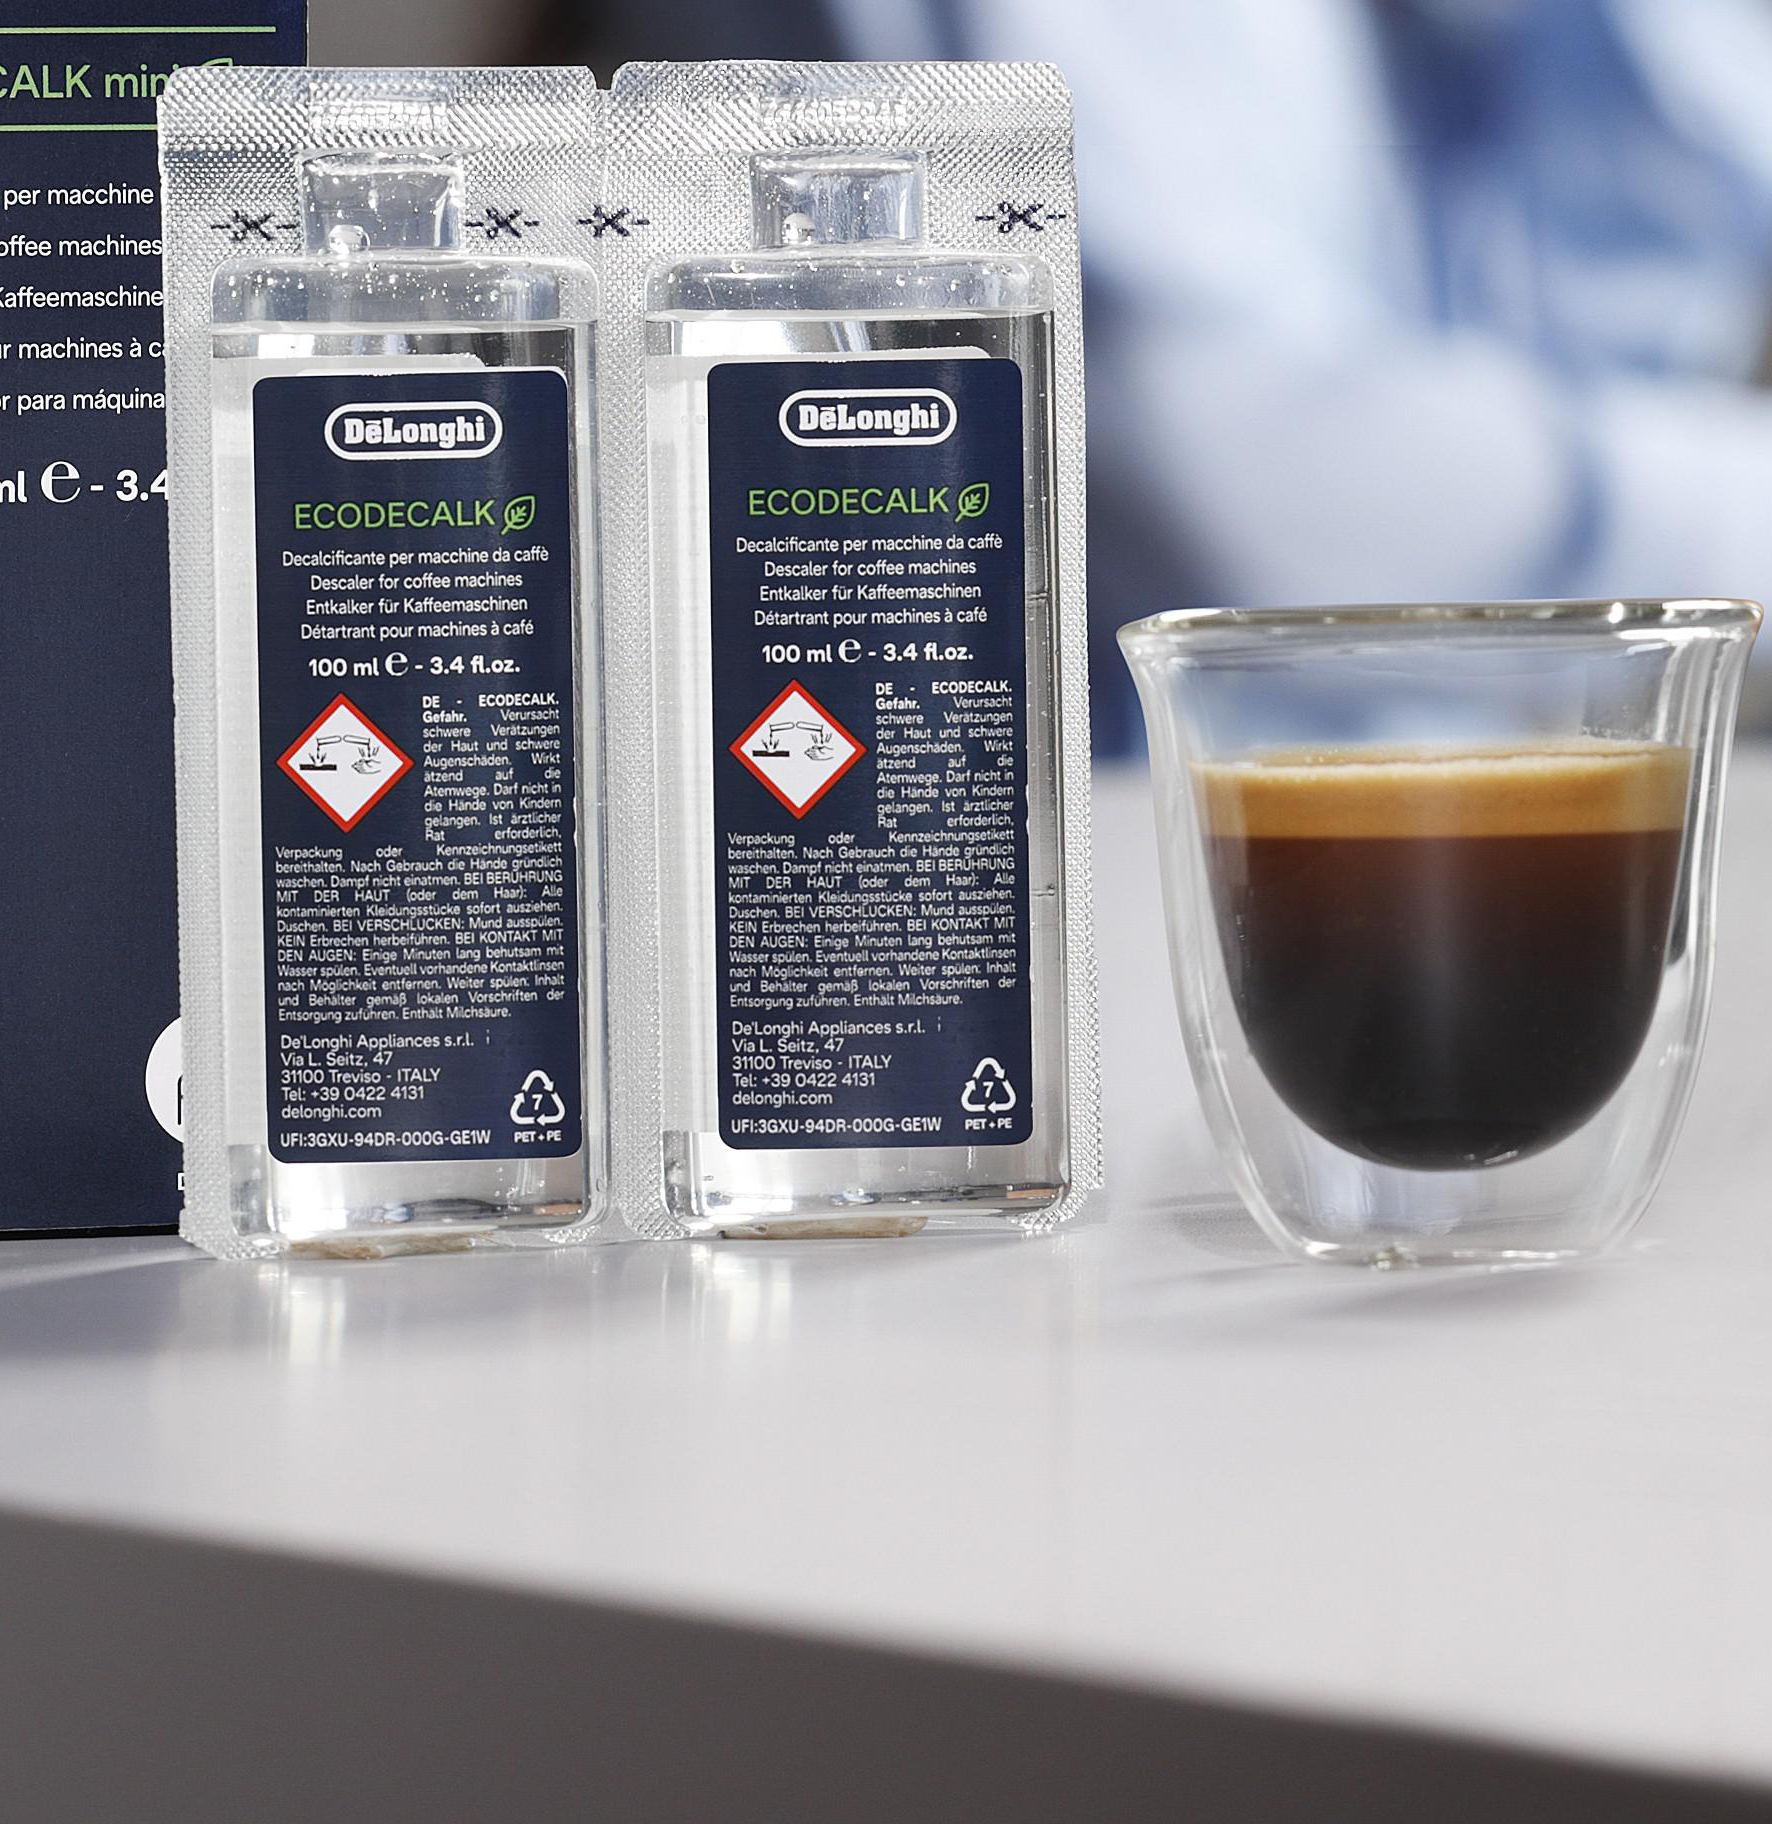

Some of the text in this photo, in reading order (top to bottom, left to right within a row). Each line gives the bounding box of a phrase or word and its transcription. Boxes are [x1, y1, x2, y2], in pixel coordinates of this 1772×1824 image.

[105, 63, 178, 98] min
[3, 189, 41, 211] per
[47, 182, 154, 205] macchine
[58, 232, 164, 260] machines
[18, 336, 124, 359] machines
[129, 337, 142, 358] à
[17, 394, 66, 416] para
[749, 486, 952, 516] ECODECALK
[295, 499, 497, 529] ECODECALK
[736, 532, 1003, 556] Decalcificante per macchine da caffè
[282, 545, 549, 569] Decalcificante per macchine da caffè
[764, 558, 977, 577] Descaler for coffee machines
[310, 571, 523, 591] Descaler for coffee machines
[759, 582, 982, 602] Entkalker für Kaffeemaschinen
[306, 595, 528, 615] Entkalker für Kaffeemaschinen
[754, 606, 988, 629] Détartrant pour machines à café
[301, 618, 534, 642] Détartrant pour machines à café
[761, 644, 801, 663] 100
[806, 643, 833, 663] ml
[882, 642, 918, 662] 3.4
[923, 642, 974, 661] fl.oz.
[308, 658, 348, 677] 100
[353, 657, 380, 677] ml
[429, 655, 465, 675] 3.4
[469, 654, 521, 674] fl.oz.
[875, 682, 894, 696] DE
[931, 679, 1013, 695] ECODECALK.
[875, 695, 1013, 711] Gefahr. Verursacht
[875, 712, 924, 725] schwere
[875, 725, 1013, 740] der Haut und schwere
[983, 739, 1013, 752] Wirkt
[732, 1018, 926, 1039] De'Longhi Appliances s.r.l.
[280, 1031, 475, 1053] De'Longhi Appliances s.r.l.
[731, 1037, 845, 1054] Via L. Seitz, 47
[280, 1051, 393, 1068] Via L. Seitz, 47
[732, 1055, 776, 1070] 31100
[779, 1055, 833, 1071] Treviso
[848, 1054, 892, 1070] ITALY
[281, 1069, 325, 1084] 31100
[328, 1068, 382, 1084] Treviso
[397, 1067, 441, 1083] ITALY
[732, 1071, 875, 1088] Tel: +39 0422 4131
[280, 1085, 424, 1102] Tel: +39 0422 4131
[982, 1081, 994, 1098] 7
[531, 1094, 543, 1111] 7
[732, 1090, 833, 1109] delonghi.com
[281, 1104, 382, 1122] delonghi.com
[964, 1118, 988, 1131] PET
[997, 1117, 1013, 1129] PE
[513, 1130, 537, 1143] PET
[546, 1130, 562, 1142] PE
